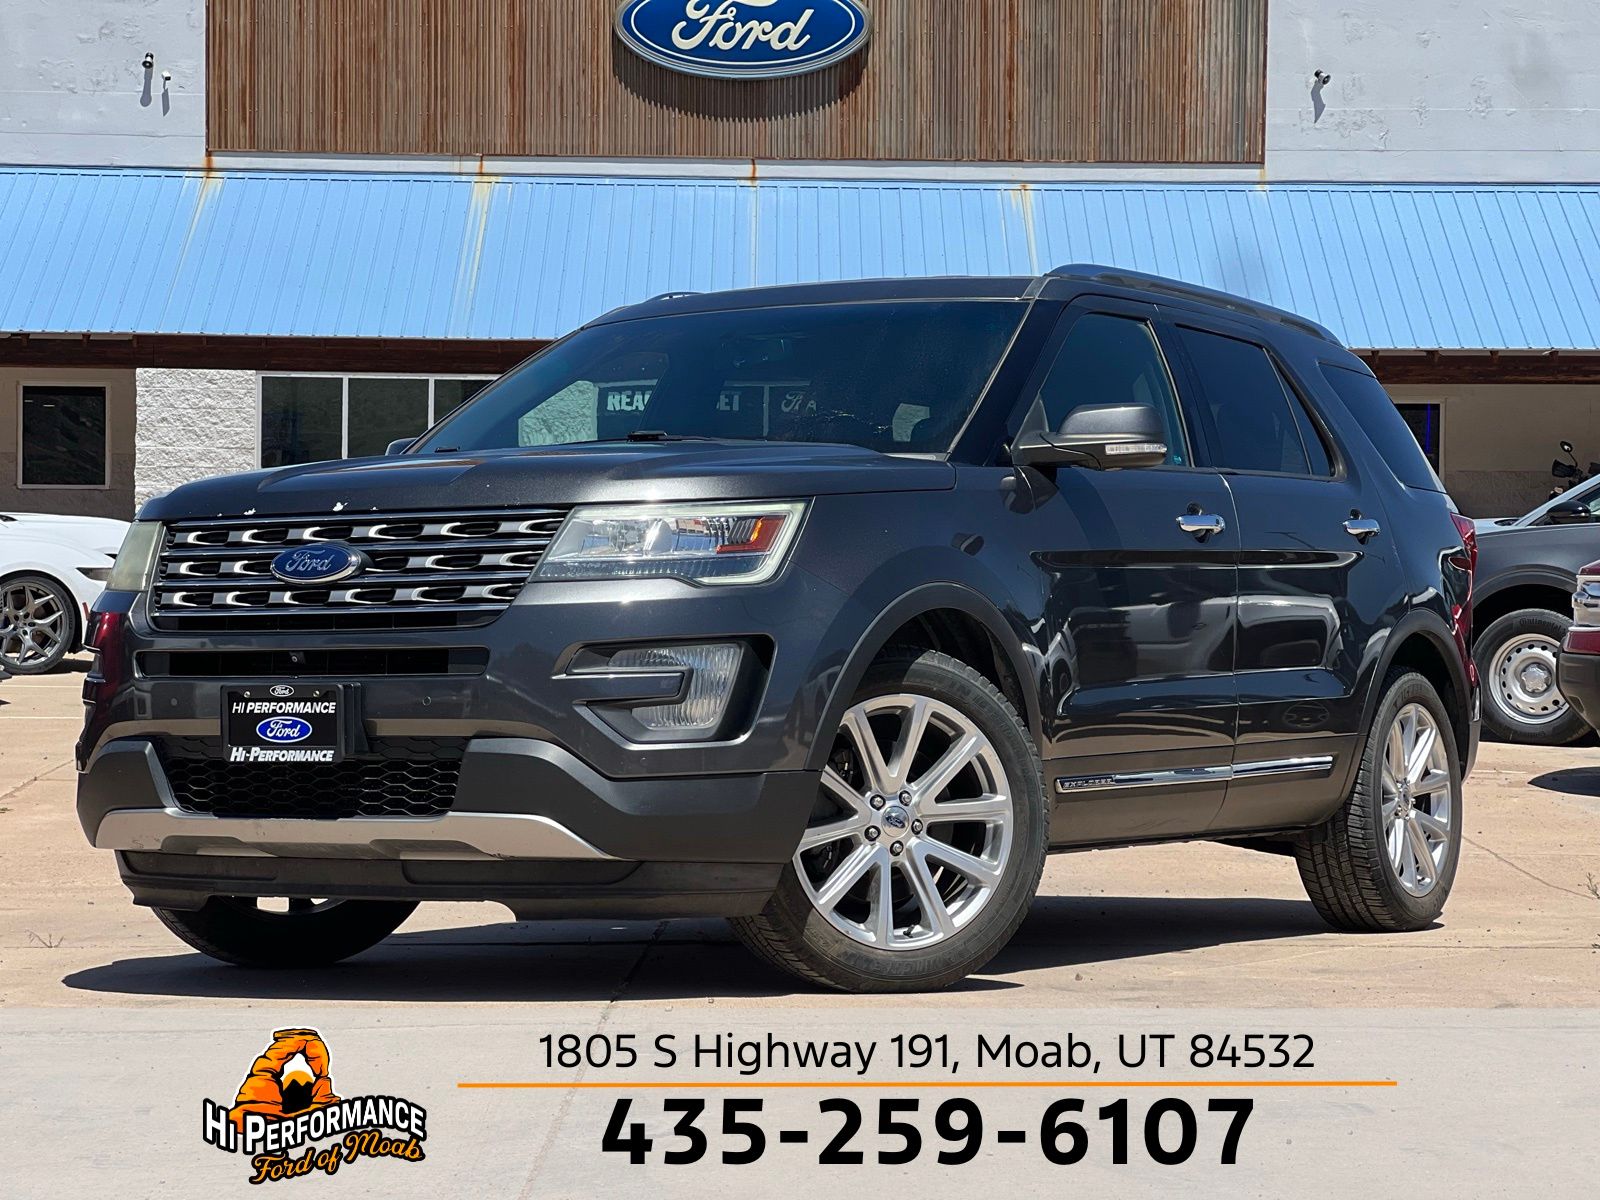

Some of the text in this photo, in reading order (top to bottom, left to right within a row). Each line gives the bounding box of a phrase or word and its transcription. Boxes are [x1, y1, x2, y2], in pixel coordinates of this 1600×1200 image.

[671, 0, 815, 51] Ford
[716, 391, 741, 411] ET
[285, 549, 336, 572] Ford
[274, 685, 290, 696] Ford
[232, 702, 336, 714] HI PERFORMANCE
[266, 720, 301, 738] Ford
